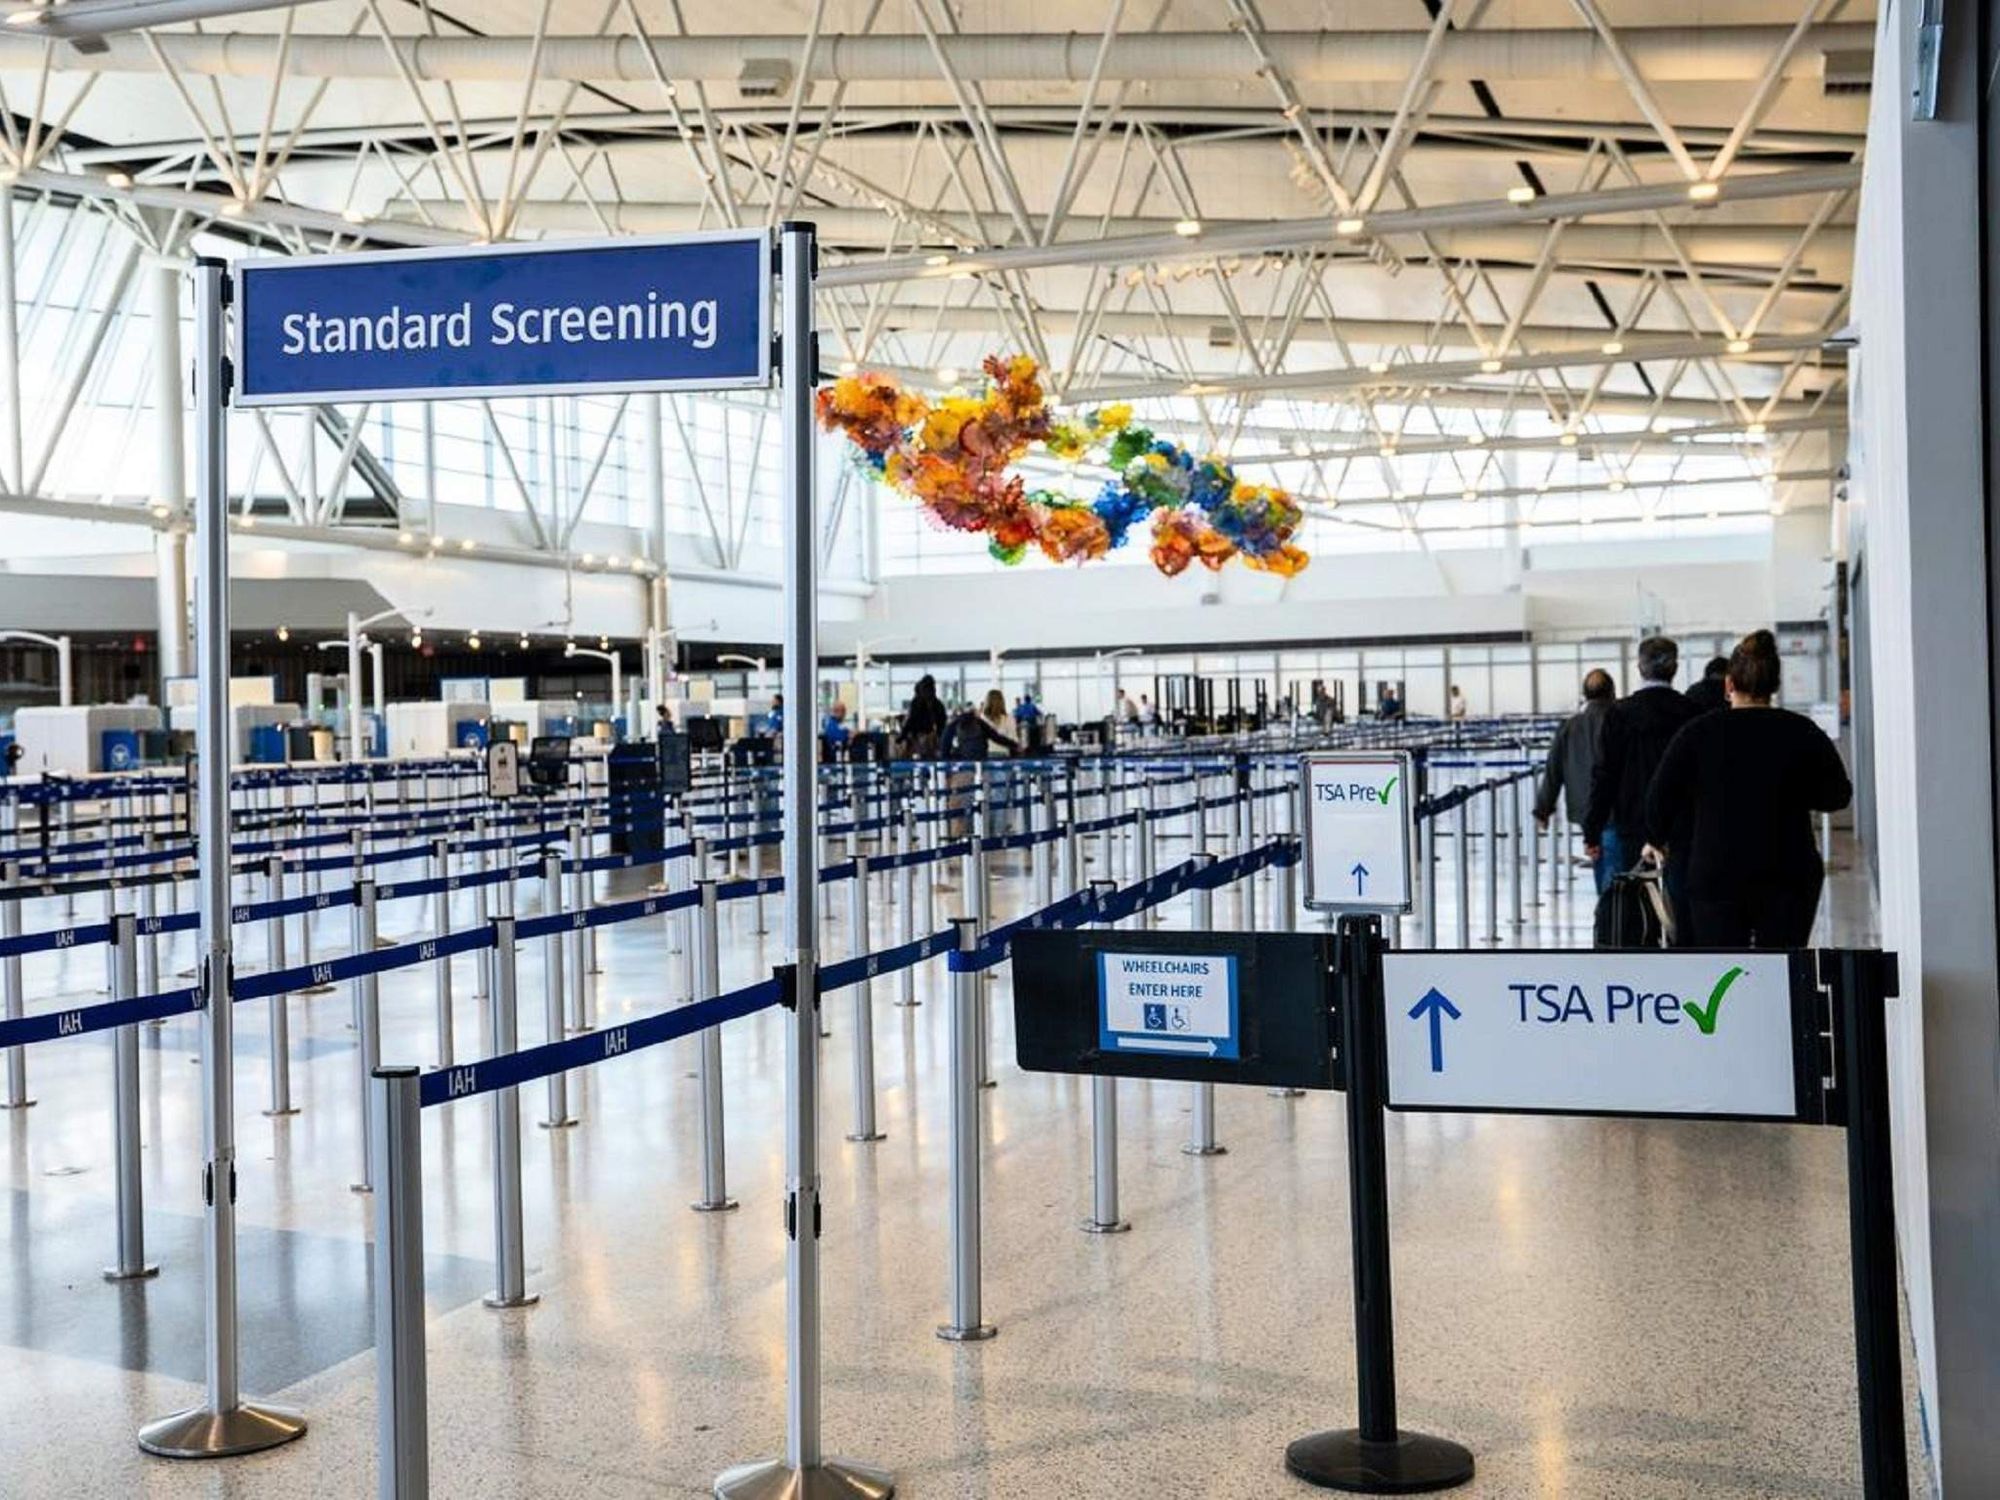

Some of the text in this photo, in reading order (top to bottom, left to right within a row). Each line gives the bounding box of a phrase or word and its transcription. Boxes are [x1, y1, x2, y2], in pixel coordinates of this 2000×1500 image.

[283, 291, 718, 354] Standard Screening
[1315, 784, 1376, 801] TSA Pre
[144, 917, 162, 933] IAH
[55, 930, 75, 948] IAH
[420, 941, 436, 960] IAH
[312, 962, 333, 983] IAH
[1122, 960, 1209, 975] WHEELCHAIRS
[1129, 983, 1203, 997] ENTER HERE
[1508, 984, 1681, 1024] TSA Pre
[58, 1012, 82, 1034] IAH
[604, 1028, 627, 1056] IAH
[448, 1067, 476, 1096] IAH
